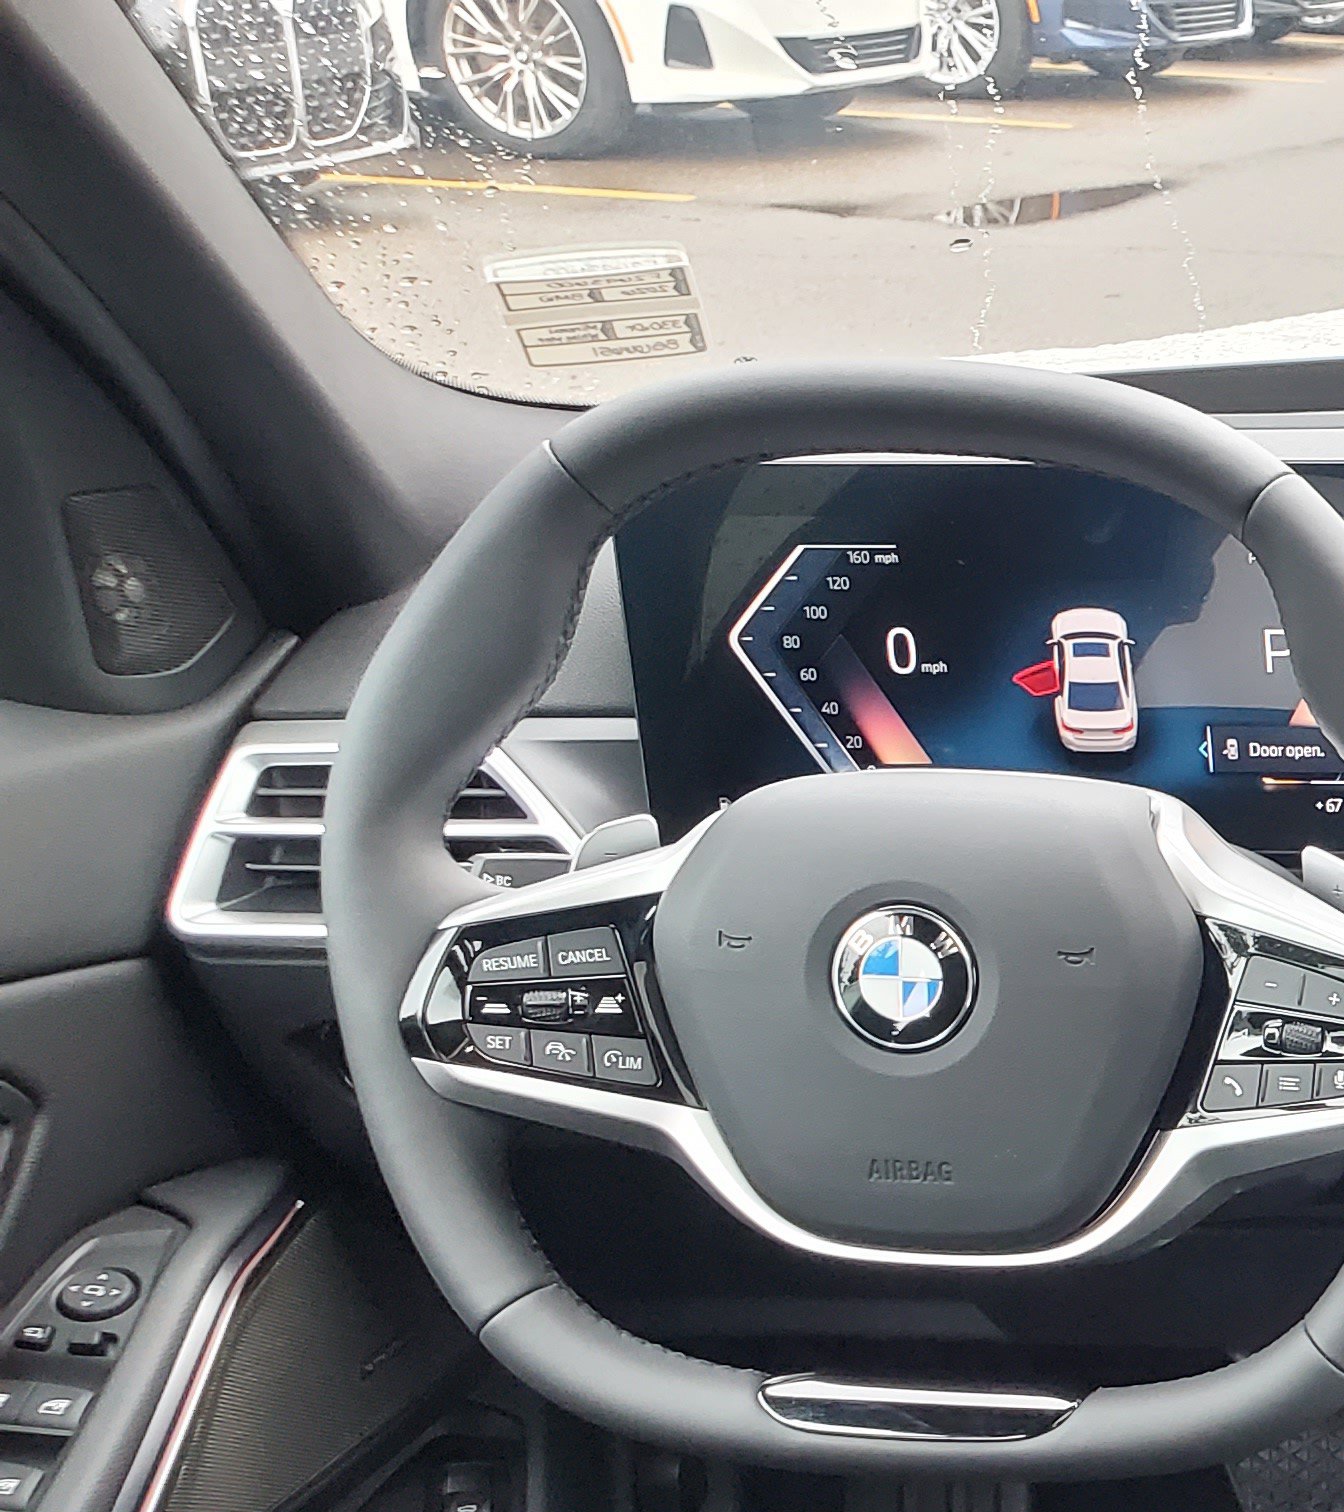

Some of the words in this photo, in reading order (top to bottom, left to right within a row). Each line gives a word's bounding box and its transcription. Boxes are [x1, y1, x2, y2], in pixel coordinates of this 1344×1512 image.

[847, 551, 870, 564] 160
[874, 553, 899, 565] mph
[826, 576, 850, 590] 120
[803, 605, 828, 620] 100
[782, 635, 800, 649] 80
[886, 626, 917, 675] 0
[921, 661, 948, 675] mph
[800, 668, 817, 681] 60
[821, 702, 839, 715] 40
[846, 736, 863, 750] 20
[1249, 742, 1283, 757] Door
[1285, 745, 1325, 760] open.
[496, 875, 512, 886] BC
[847, 915, 959, 959] BMW
[482, 954, 538, 972] RESUME
[558, 948, 611, 966] CANCEL
[486, 1036, 512, 1049] SET
[618, 1056, 642, 1070] LIM
[868, 1158, 955, 1185] AIRBAG
